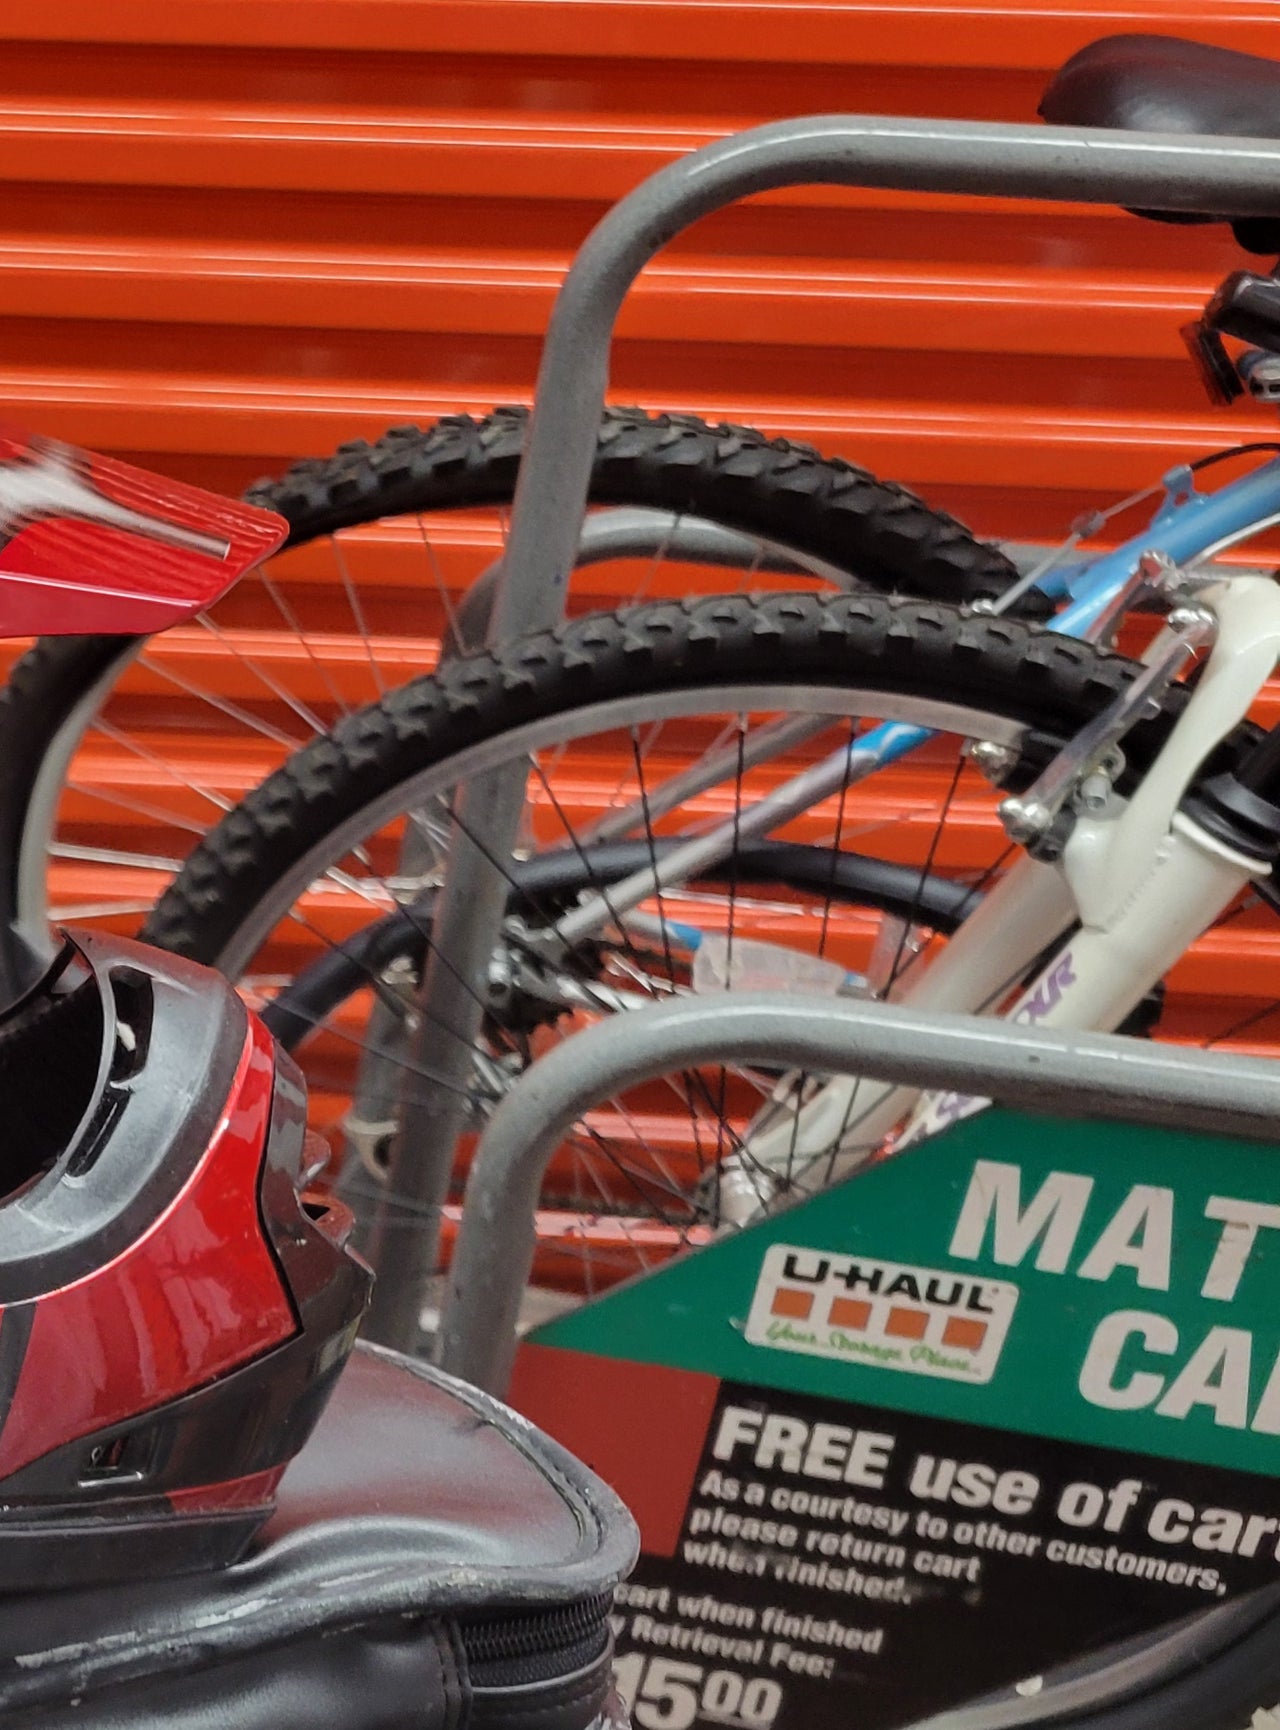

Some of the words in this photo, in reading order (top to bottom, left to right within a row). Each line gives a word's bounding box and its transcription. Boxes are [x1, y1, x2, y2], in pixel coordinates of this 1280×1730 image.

[782, 1254, 994, 1314] U-HAUL
[712, 1405, 896, 1490] FREE
[909, 1454, 1040, 1515] use
[1057, 1479, 1142, 1532] of
[1147, 1498, 1280, 1564] car
[683, 1541, 766, 1576] when
[689, 1507, 798, 1546] please
[805, 1531, 907, 1568] return
[913, 1550, 982, 1582] cart
[699, 1470, 740, 1500] As
[743, 1482, 766, 1506] a
[770, 1487, 910, 1536] courtesy
[915, 1510, 948, 1540] to
[953, 1520, 1041, 1557] other
[1045, 1539, 1227, 1596] customers,
[612, 1582, 670, 1612] cart
[677, 1595, 756, 1629] when
[761, 1606, 884, 1654] finished
[631, 1614, 765, 1664] Retrieval
[769, 1643, 836, 1679] Fee:
